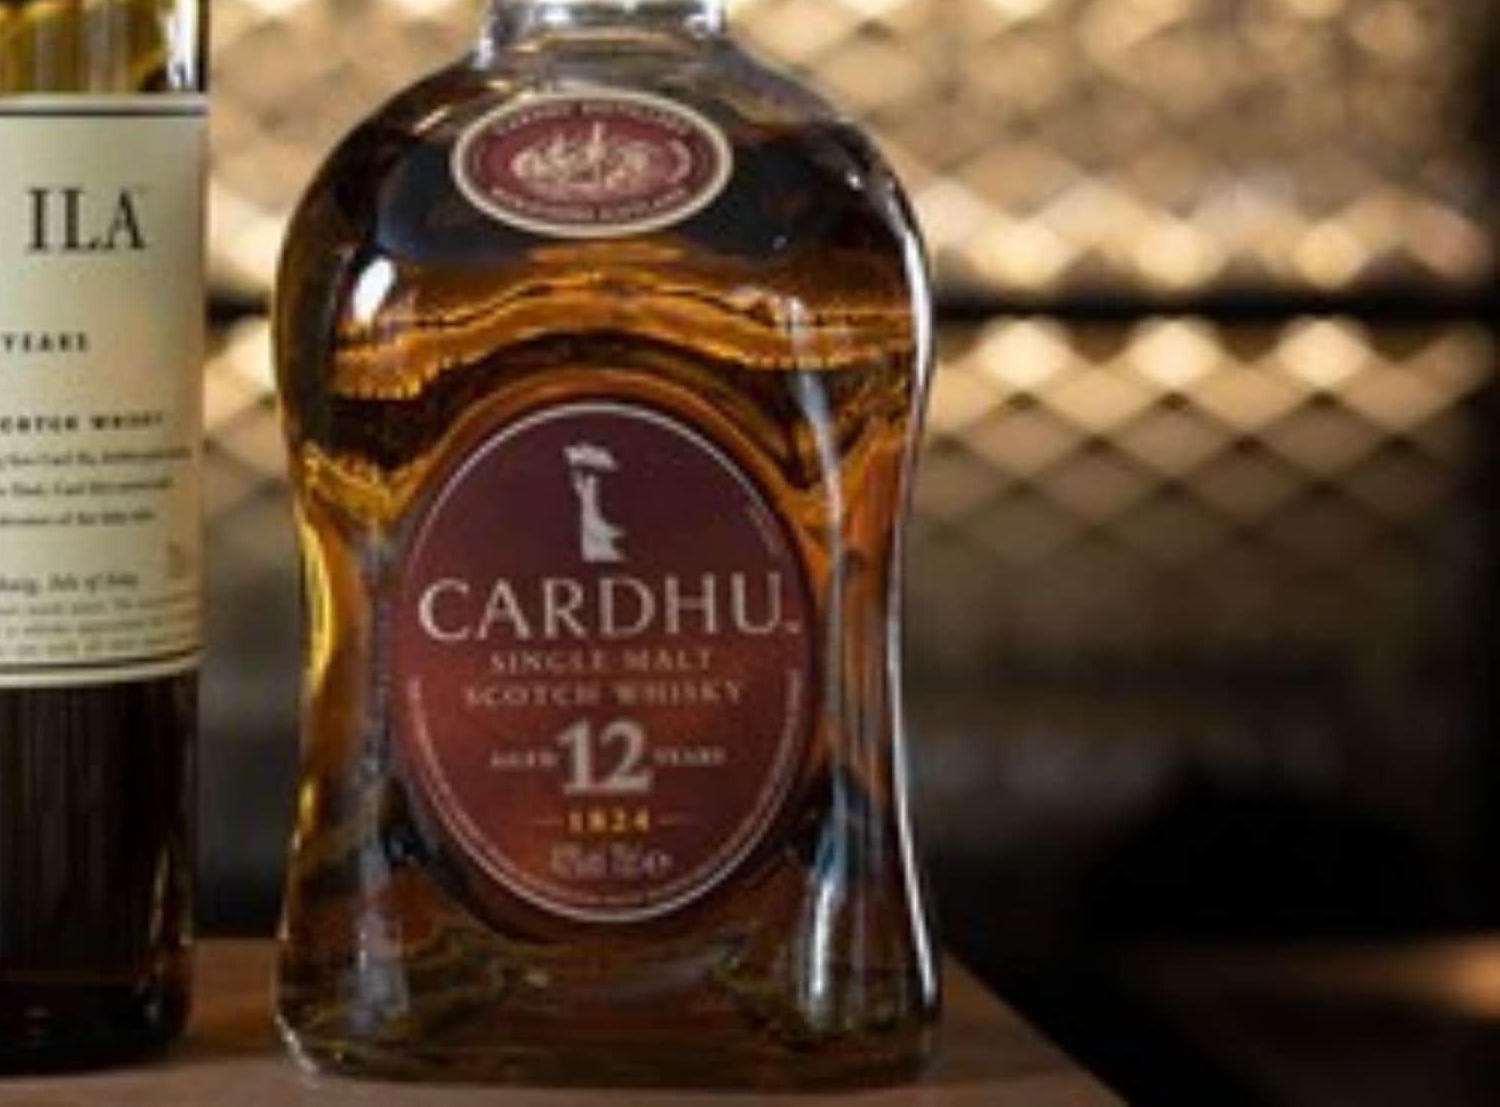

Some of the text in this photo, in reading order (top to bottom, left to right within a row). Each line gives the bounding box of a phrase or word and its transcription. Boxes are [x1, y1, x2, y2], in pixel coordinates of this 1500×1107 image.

[27, 187, 149, 252] ILA
[1, 331, 90, 353] YEARS
[417, 572, 783, 641] CARDHU
[621, 647, 714, 672] MALT
[556, 717, 654, 797] 12
